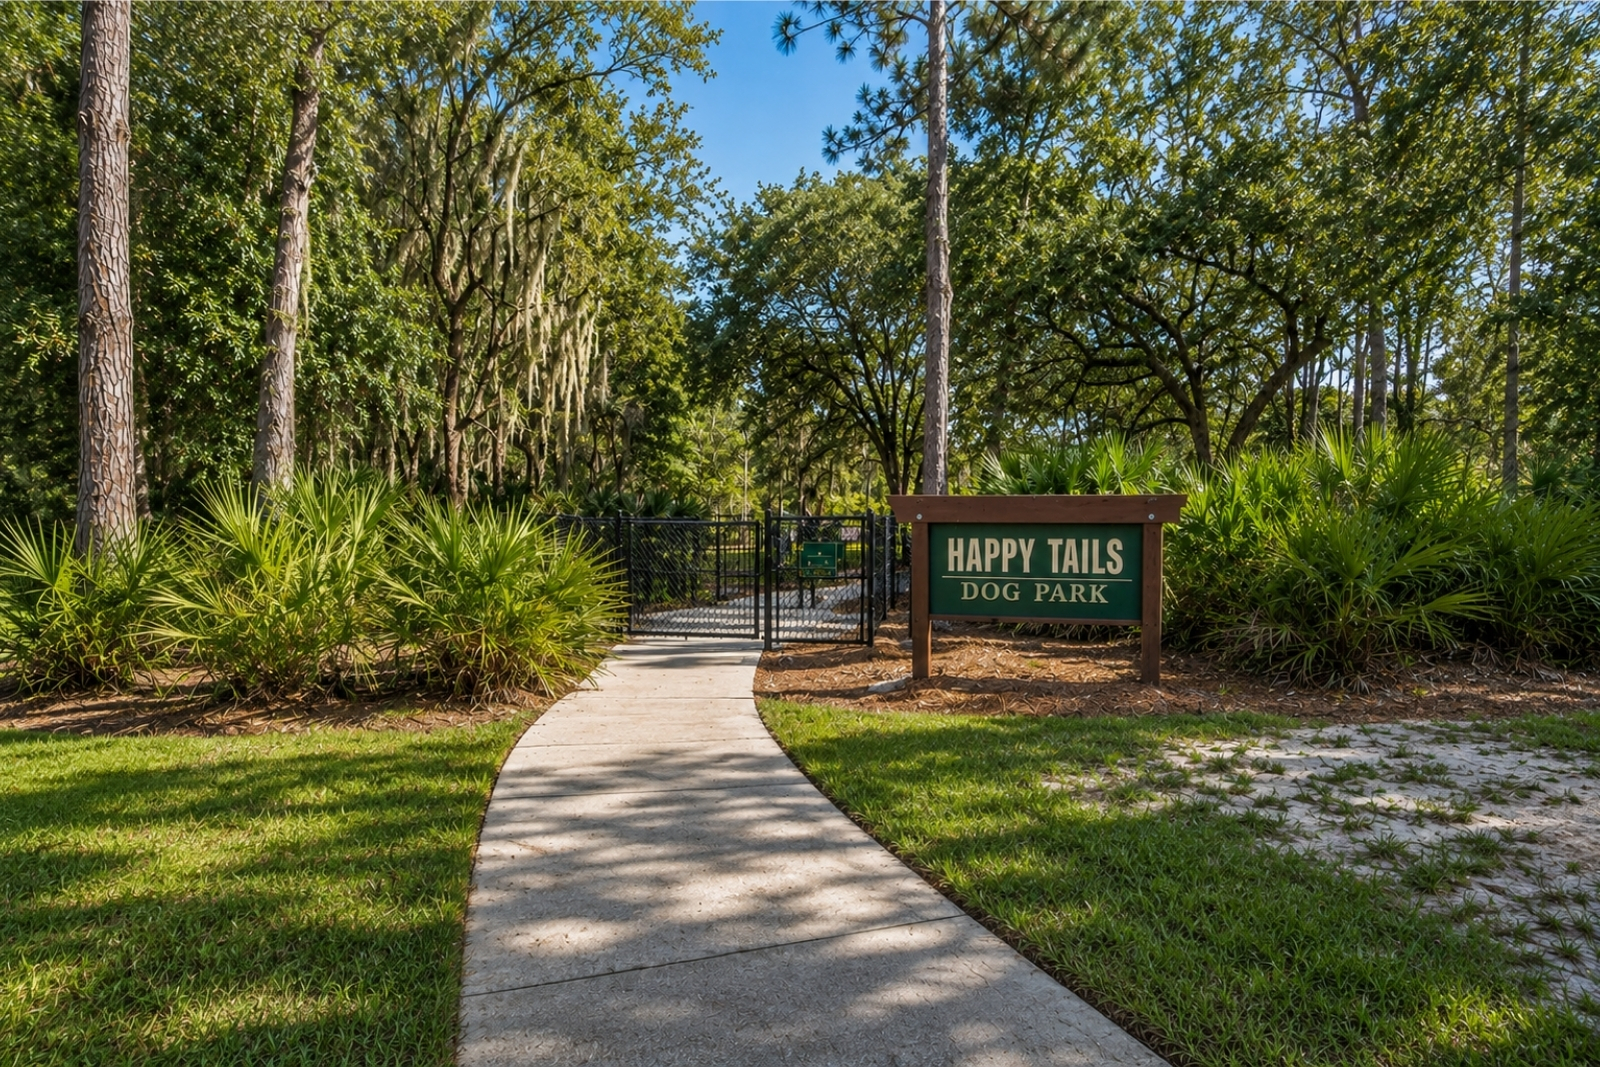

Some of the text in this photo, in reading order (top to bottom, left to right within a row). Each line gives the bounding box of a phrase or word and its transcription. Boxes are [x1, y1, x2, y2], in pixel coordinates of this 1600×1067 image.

[947, 537, 1124, 574] HAPPY TAILS
[960, 582, 1109, 604] DOG PARK
